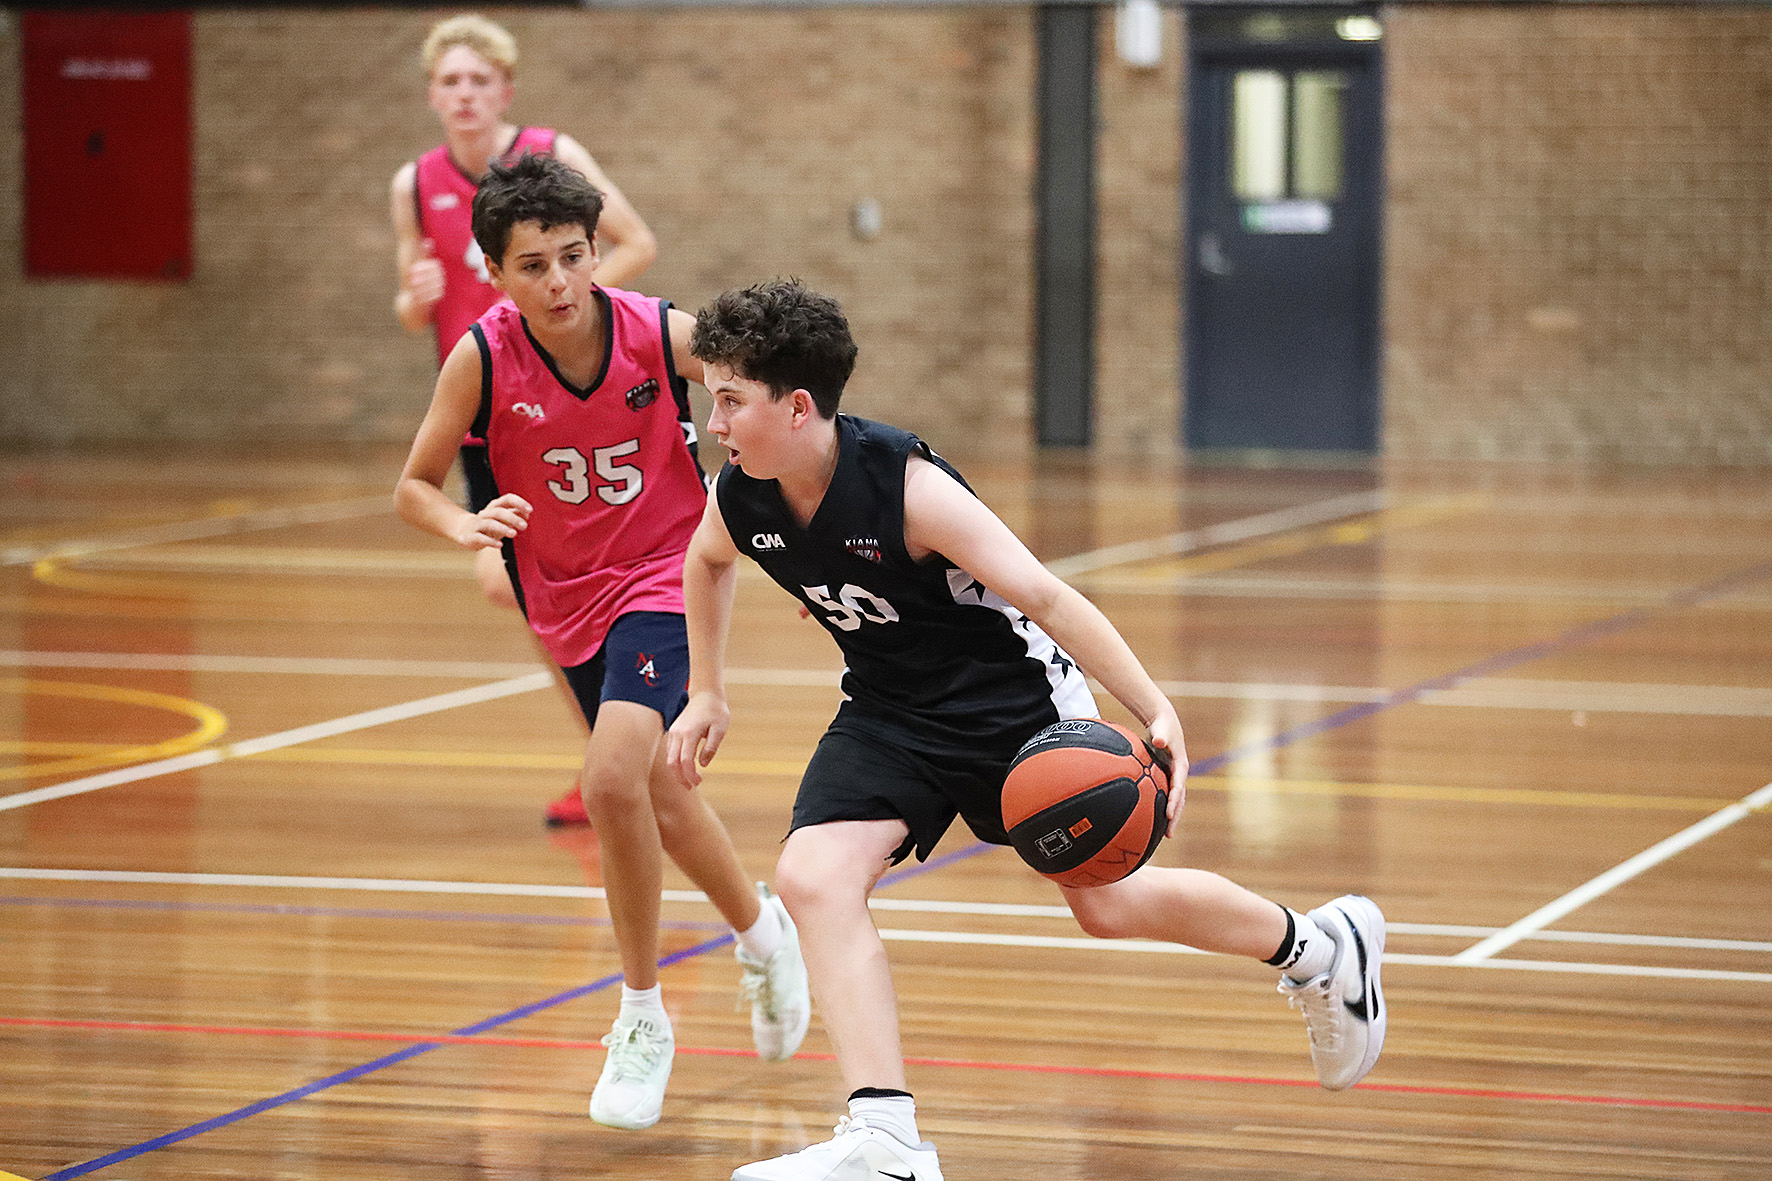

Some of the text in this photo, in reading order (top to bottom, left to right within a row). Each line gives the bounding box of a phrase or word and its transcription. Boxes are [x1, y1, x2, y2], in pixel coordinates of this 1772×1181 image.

[541, 437, 643, 505] 35
[751, 533, 786, 549] CWA
[845, 538, 879, 547] KIAMA
[800, 583, 900, 631] 50
